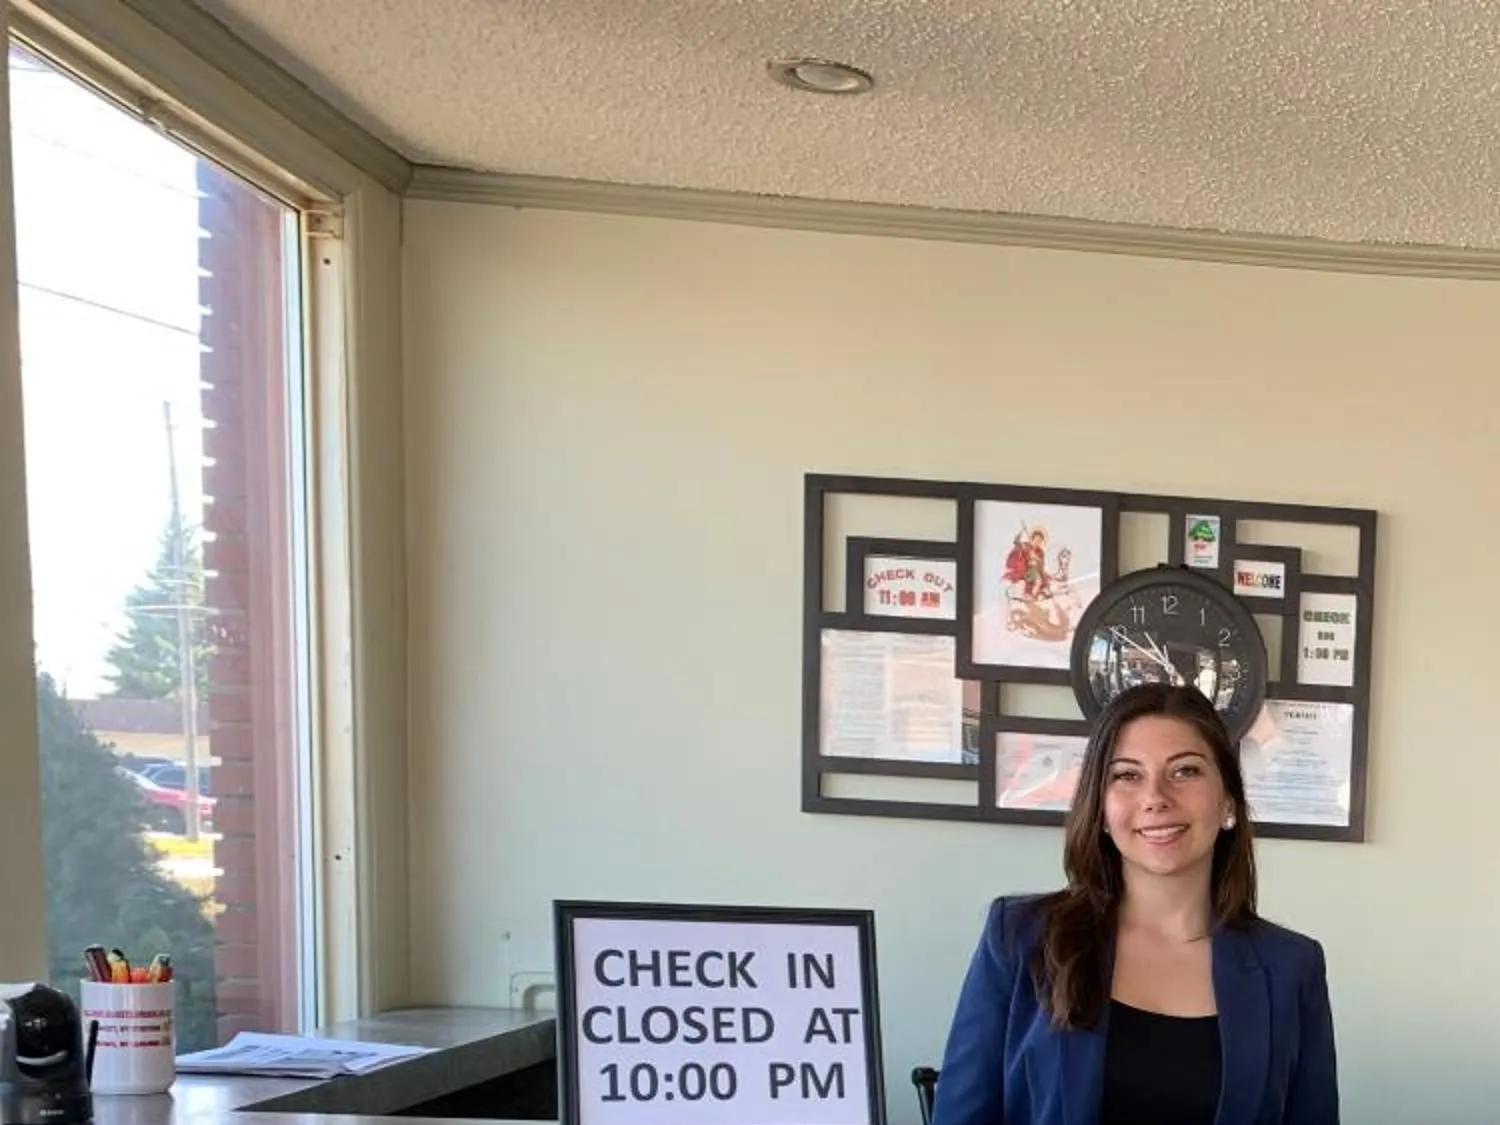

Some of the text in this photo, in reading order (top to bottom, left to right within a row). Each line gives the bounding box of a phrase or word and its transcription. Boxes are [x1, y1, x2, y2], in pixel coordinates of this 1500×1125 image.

[867, 568, 953, 592] CHECK OUT
[1237, 571, 1281, 589] WELCOME
[1130, 605, 1146, 625] 11
[1162, 595, 1180, 615] 12
[1303, 610, 1351, 625] CHECK
[1218, 628, 1231, 647] 2
[1333, 648, 1349, 661] PM
[594, 948, 836, 989] CHECK IN
[581, 1004, 860, 1044] CLOSED AT
[600, 1062, 845, 1102] 10:00 PM
